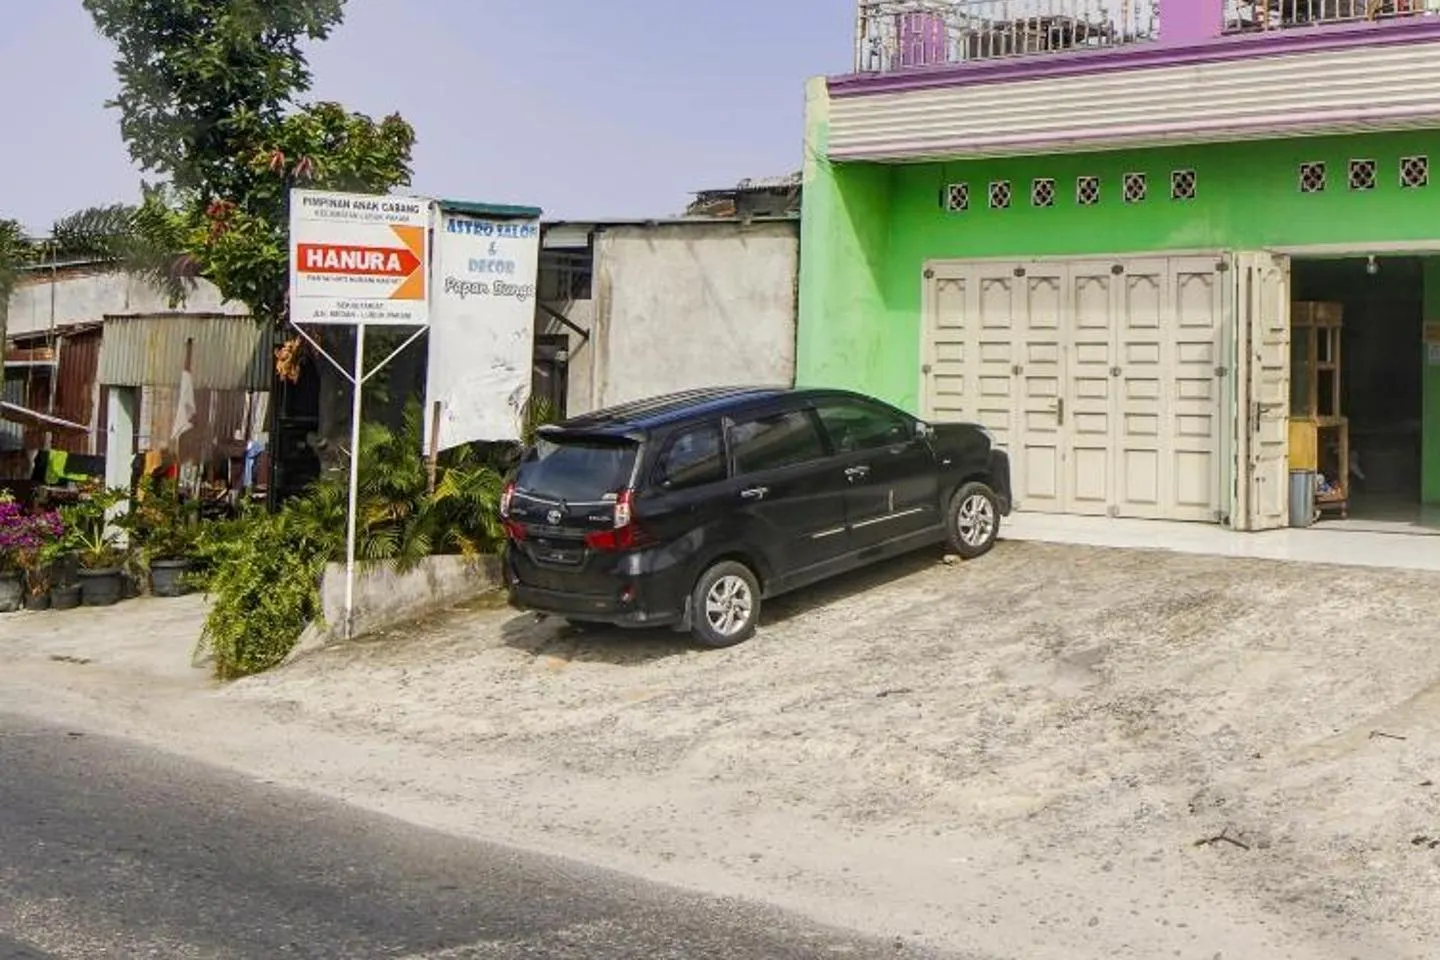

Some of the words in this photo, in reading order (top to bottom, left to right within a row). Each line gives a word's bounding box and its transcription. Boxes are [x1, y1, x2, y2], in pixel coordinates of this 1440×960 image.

[303, 197, 351, 209] PIMPINAN
[353, 200, 380, 212] ANAK
[381, 203, 420, 214] CABANG
[306, 248, 402, 272] HANURA
[444, 276, 490, 300] Papan
